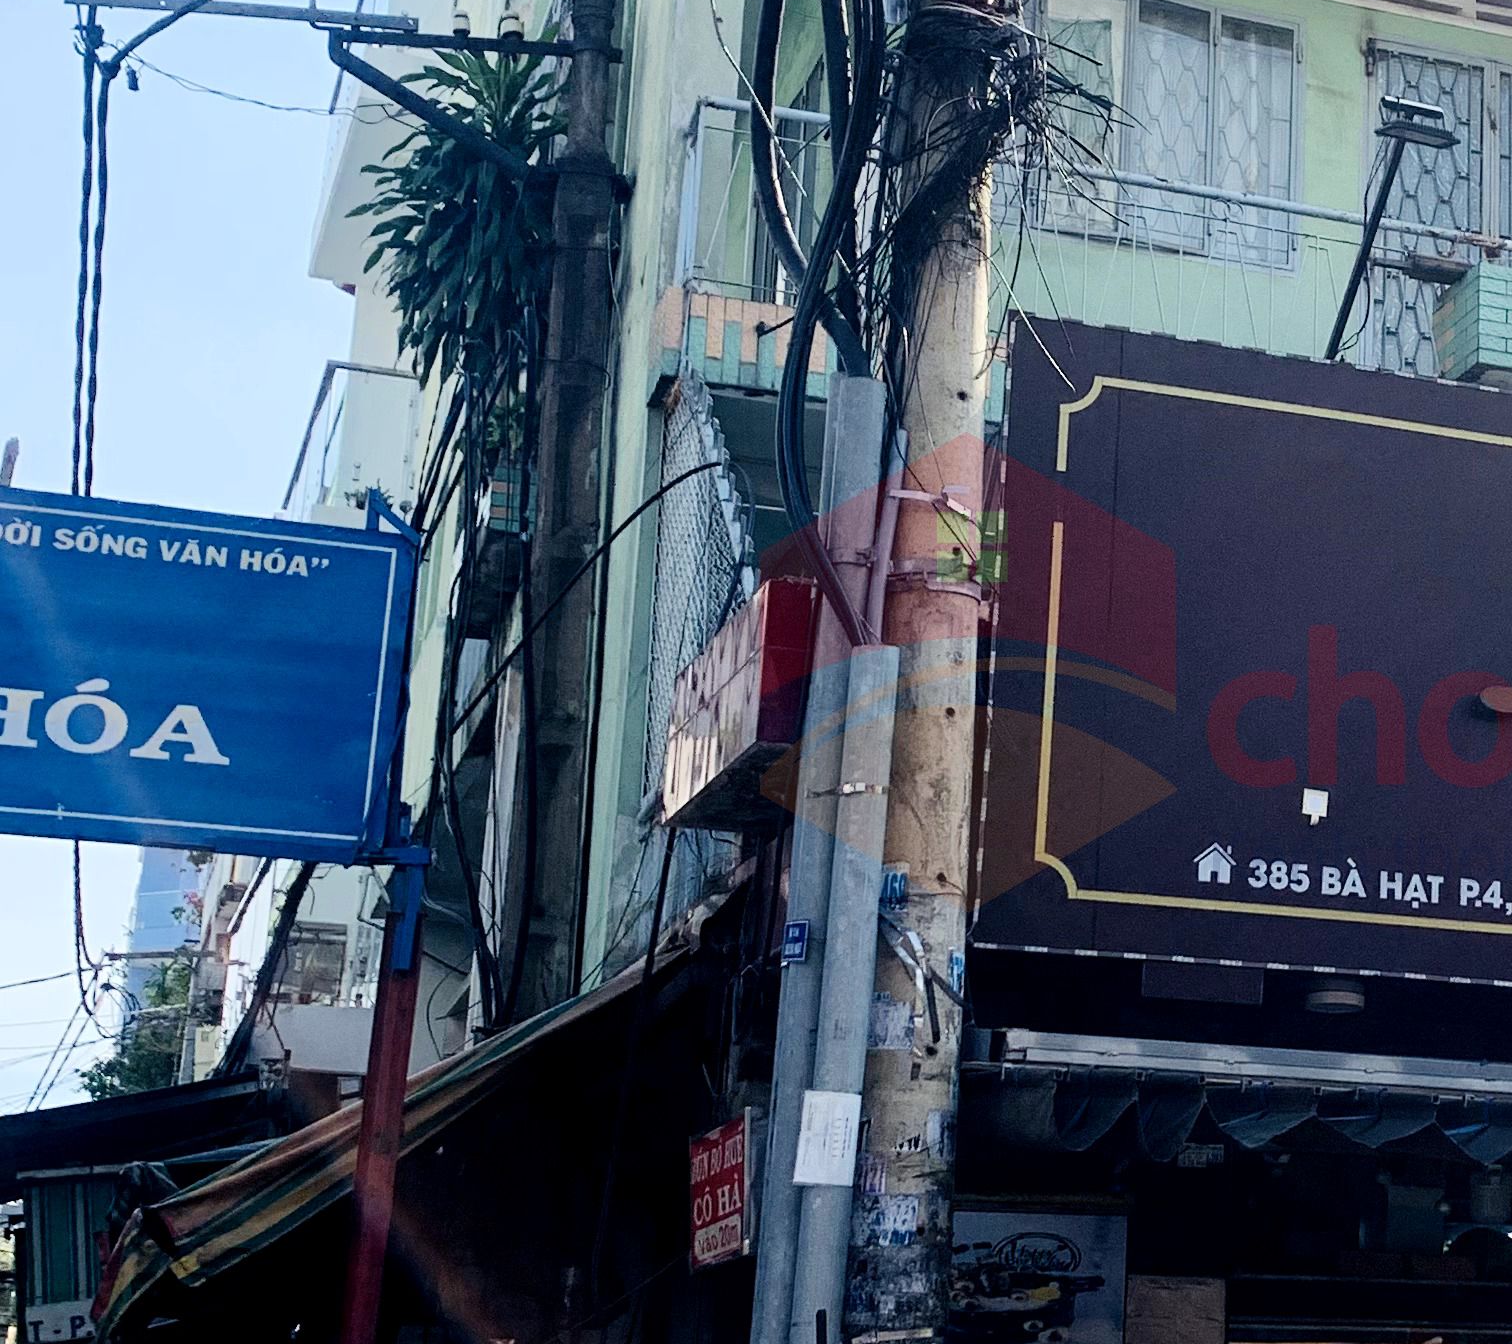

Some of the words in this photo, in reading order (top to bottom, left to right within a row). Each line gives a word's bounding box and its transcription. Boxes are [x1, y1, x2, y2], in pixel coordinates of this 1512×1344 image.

[0, 516, 42, 547] ỜI
[52, 524, 148, 560] SỐNG
[160, 537, 228, 568] VĂN
[1247, 858, 1311, 894] 385
[1320, 857, 1367, 898] BÀ
[1379, 870, 1445, 910] HẠT
[693, 1186, 713, 1227] CÔ
